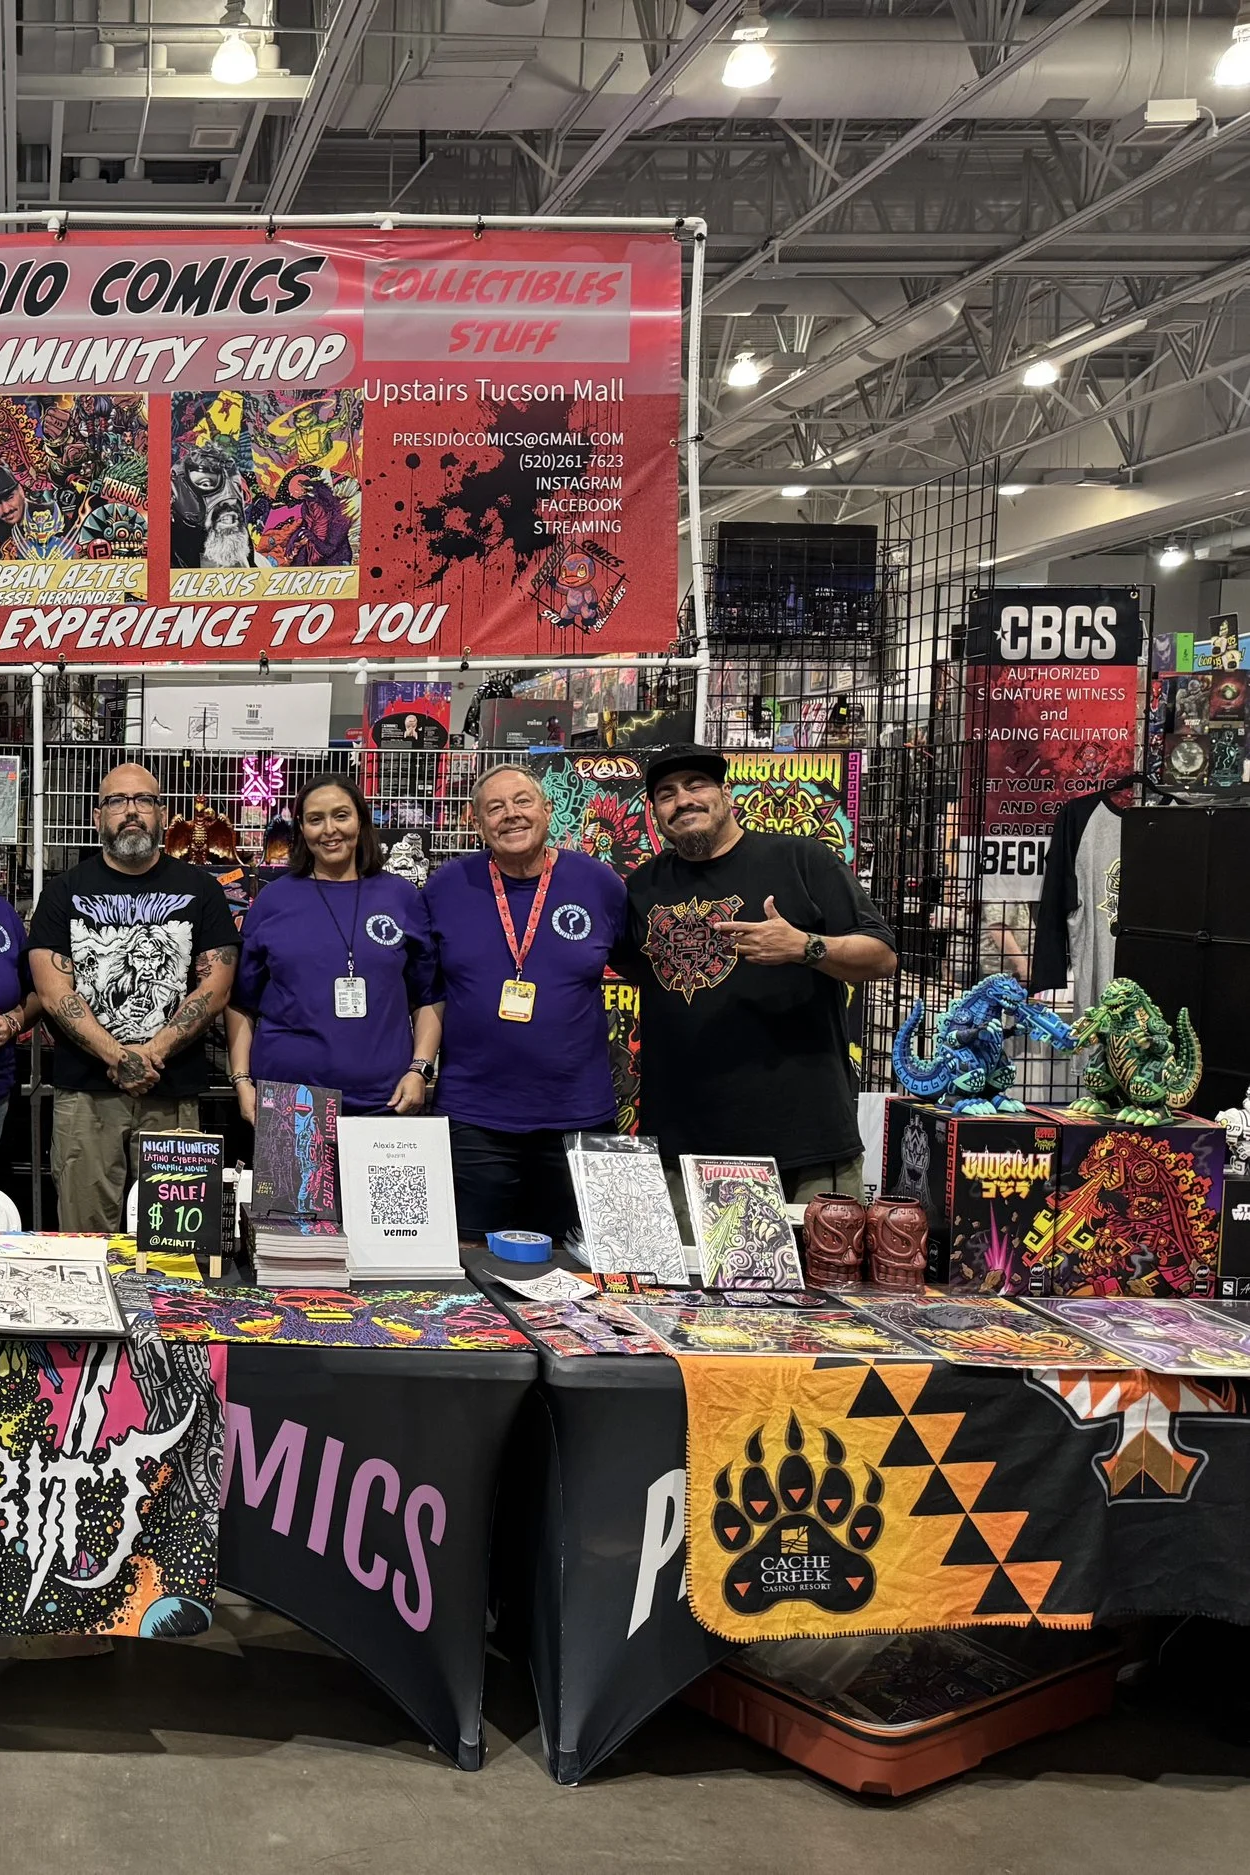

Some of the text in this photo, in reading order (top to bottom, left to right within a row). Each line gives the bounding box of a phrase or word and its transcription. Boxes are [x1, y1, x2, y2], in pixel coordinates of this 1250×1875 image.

[89, 255, 325, 318] COMICS
[370, 267, 624, 306] COLLECTIBLES
[448, 319, 563, 355] STUFF
[214, 332, 348, 384] SHOP
[363, 378, 625, 406] Upstairs Tucson Mall
[393, 431, 624, 449] PRESIDIOCOMICS@GMAIL.COM
[519, 453, 624, 472] (520)261-7623
[536, 476, 622, 491] INSTAGRAM
[540, 498, 623, 513] FACEBOOK
[533, 520, 622, 535] STREAMING
[58, 562, 144, 590] AZTEC
[170, 569, 356, 598] ALEXIS ZIRITT
[37, 589, 124, 606] HERNANDEZ
[271, 604, 335, 646] TO
[350, 601, 451, 644] YOU
[1000, 605, 1117, 661] CBCS
[1007, 667, 1100, 681] AUTHORIZED
[977, 687, 1125, 702] SGNATURE WITNESS
[1039, 707, 1068, 721] and
[1042, 728, 1128, 741] FACILITATOR
[575, 757, 642, 780] P.O.D.
[722, 753, 843, 791] MASTODON
[1007, 778, 1055, 793] YOUR
[999, 801, 1036, 814] AND
[142, 1140, 220, 1155] NIGHT HUNTERS
[322, 1097, 337, 1210] NIGHT HUNTERS
[144, 1154, 169, 1163] LATINO
[151, 1162, 183, 1172] GRAPHIC
[961, 1150, 1054, 1181] GODZILLA
[704, 1165, 770, 1183] GODZILLA
[158, 1182, 206, 1202] SALE!
[981, 1180, 1031, 1199] ゴジラ
[383, 1229, 418, 1237] venmo
[760, 1555, 831, 1570] CACHE
[760, 1570, 831, 1584] CREEK
